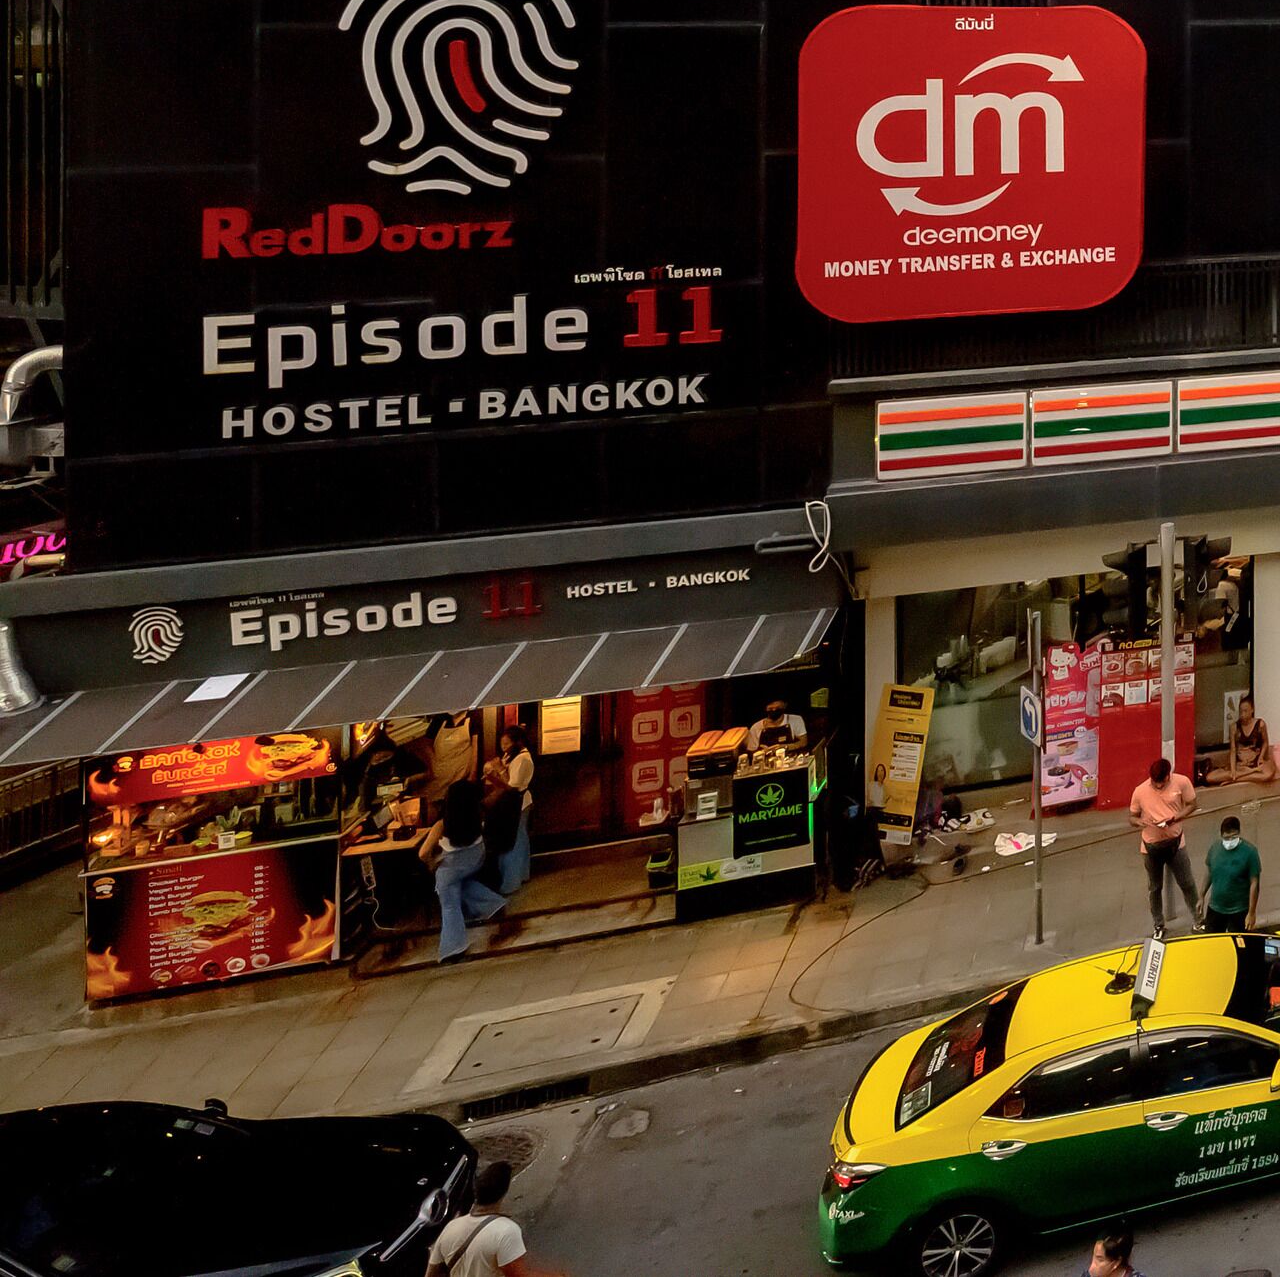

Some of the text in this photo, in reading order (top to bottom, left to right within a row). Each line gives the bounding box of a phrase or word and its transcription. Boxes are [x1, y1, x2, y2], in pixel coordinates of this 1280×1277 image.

[954, 13, 995, 31] ดีมันนี่
[855, 78, 1065, 178] dm
[200, 203, 515, 260] RedDoorz
[902, 223, 1044, 247] deemoney
[824, 246, 1116, 278] MONEY TRANSFER & EXCHANGE
[203, 285, 724, 389] Episode 11
[222, 373, 710, 439] HOSTEL BANGKOK
[566, 568, 751, 599] HOSTEL BANGKOK
[229, 580, 543, 652] Episode 11
[151, 760, 228, 786] BURGER
[738, 803, 803, 824] MARYJANE
[176, 882, 199, 892] Burger
[179, 874, 205, 884] Burger
[167, 891, 193, 901] Burger
[167, 949, 194, 960] Burger
[171, 955, 197, 967] Burger
[835, 1209, 855, 1219] TAXI
